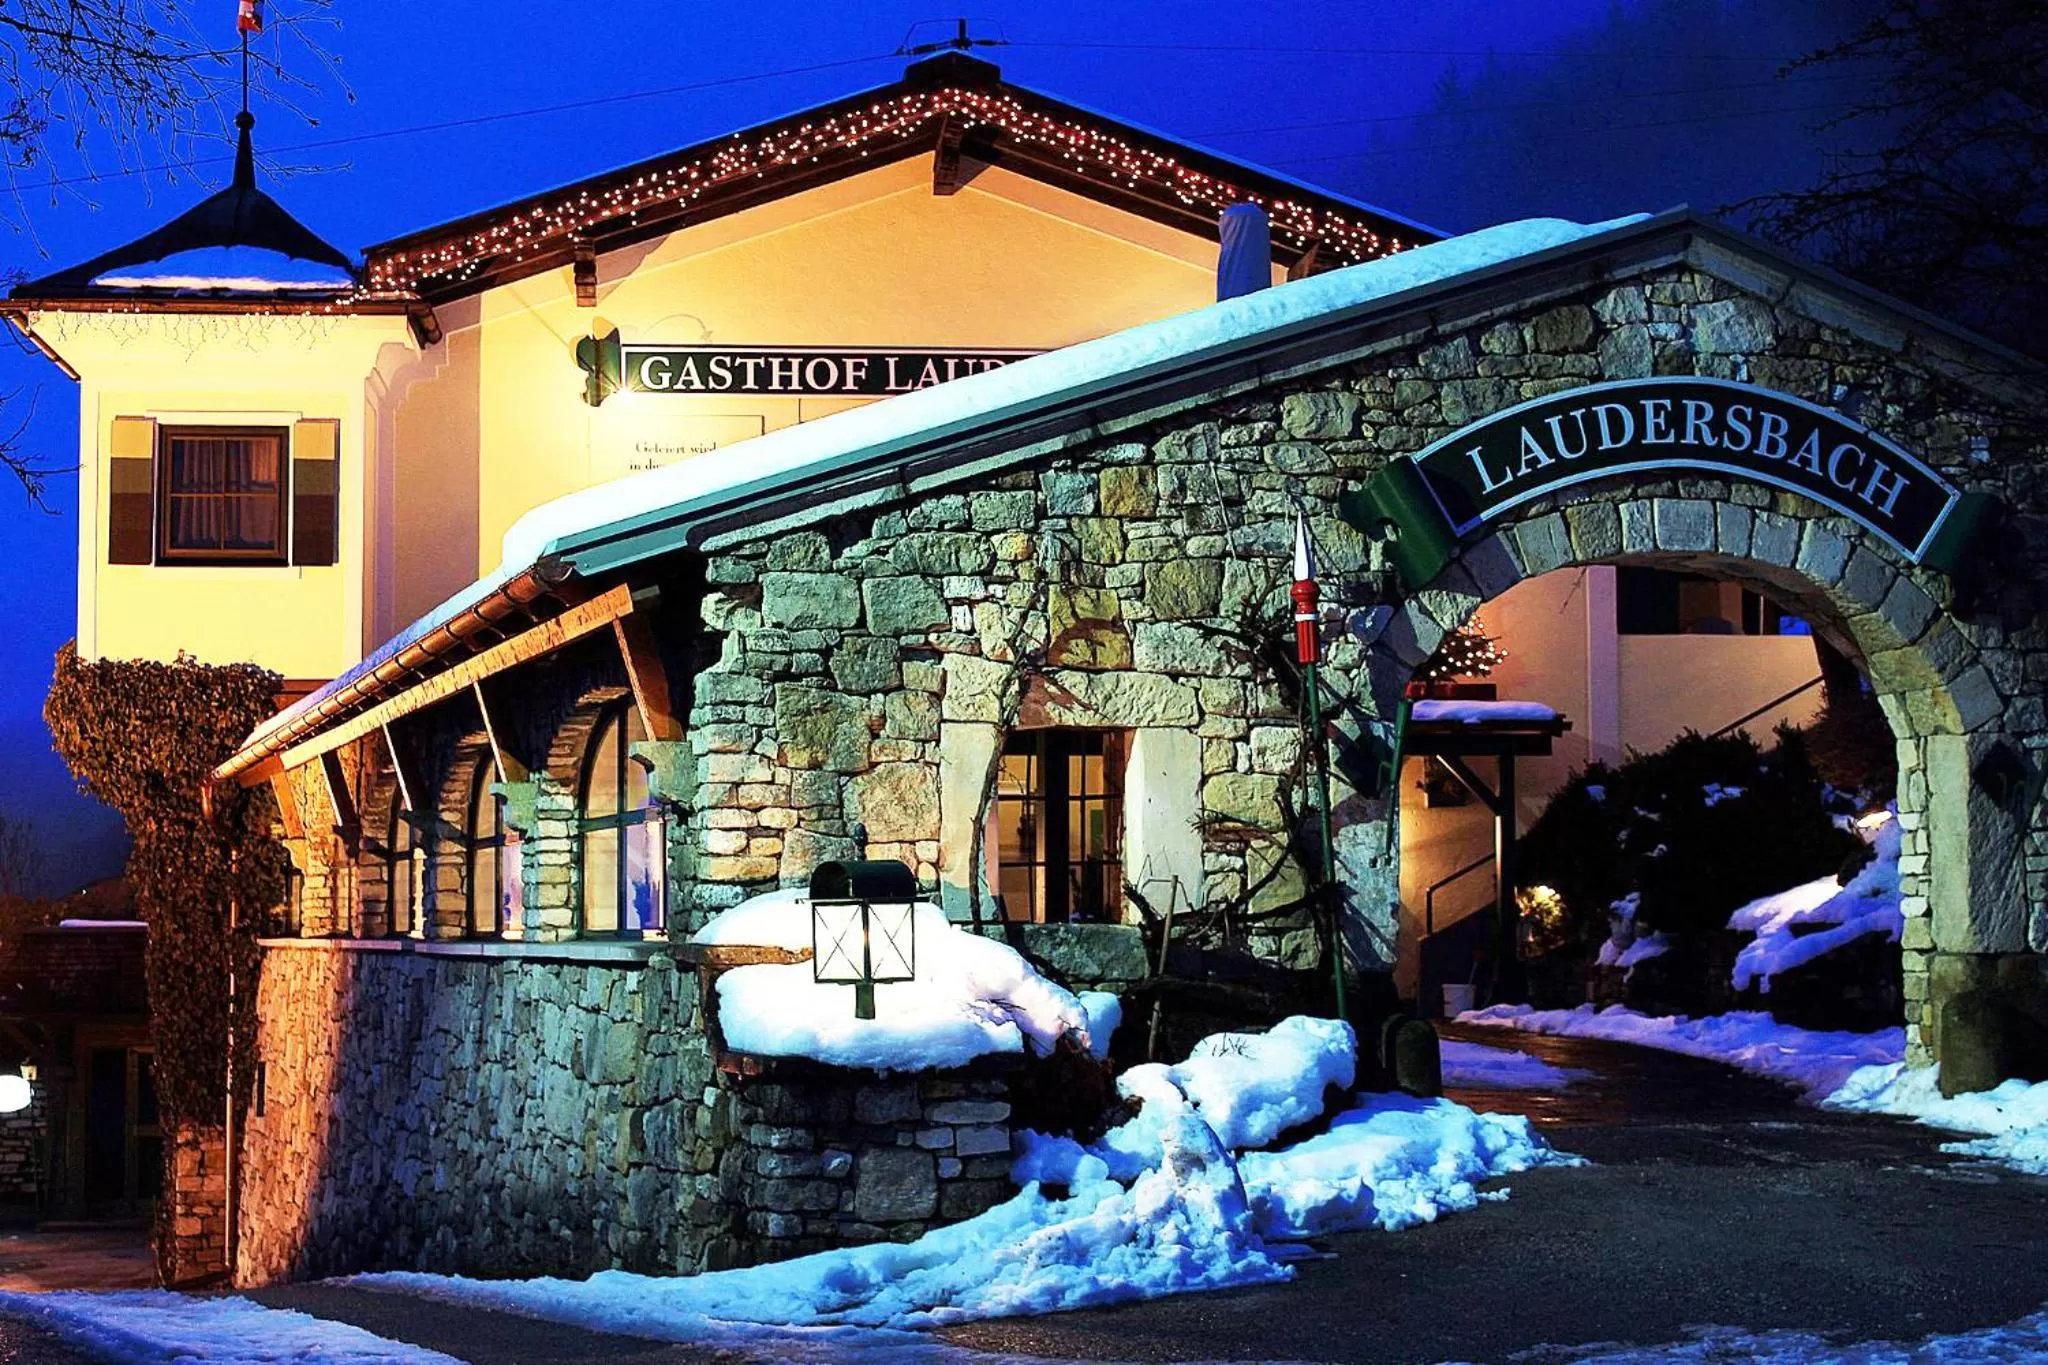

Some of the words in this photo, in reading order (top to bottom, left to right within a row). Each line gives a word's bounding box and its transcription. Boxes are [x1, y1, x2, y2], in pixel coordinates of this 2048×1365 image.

[640, 355, 867, 391] GASTHOF
[885, 357, 1007, 391] LAU
[1465, 399, 1911, 518] LAUDERSBACH
